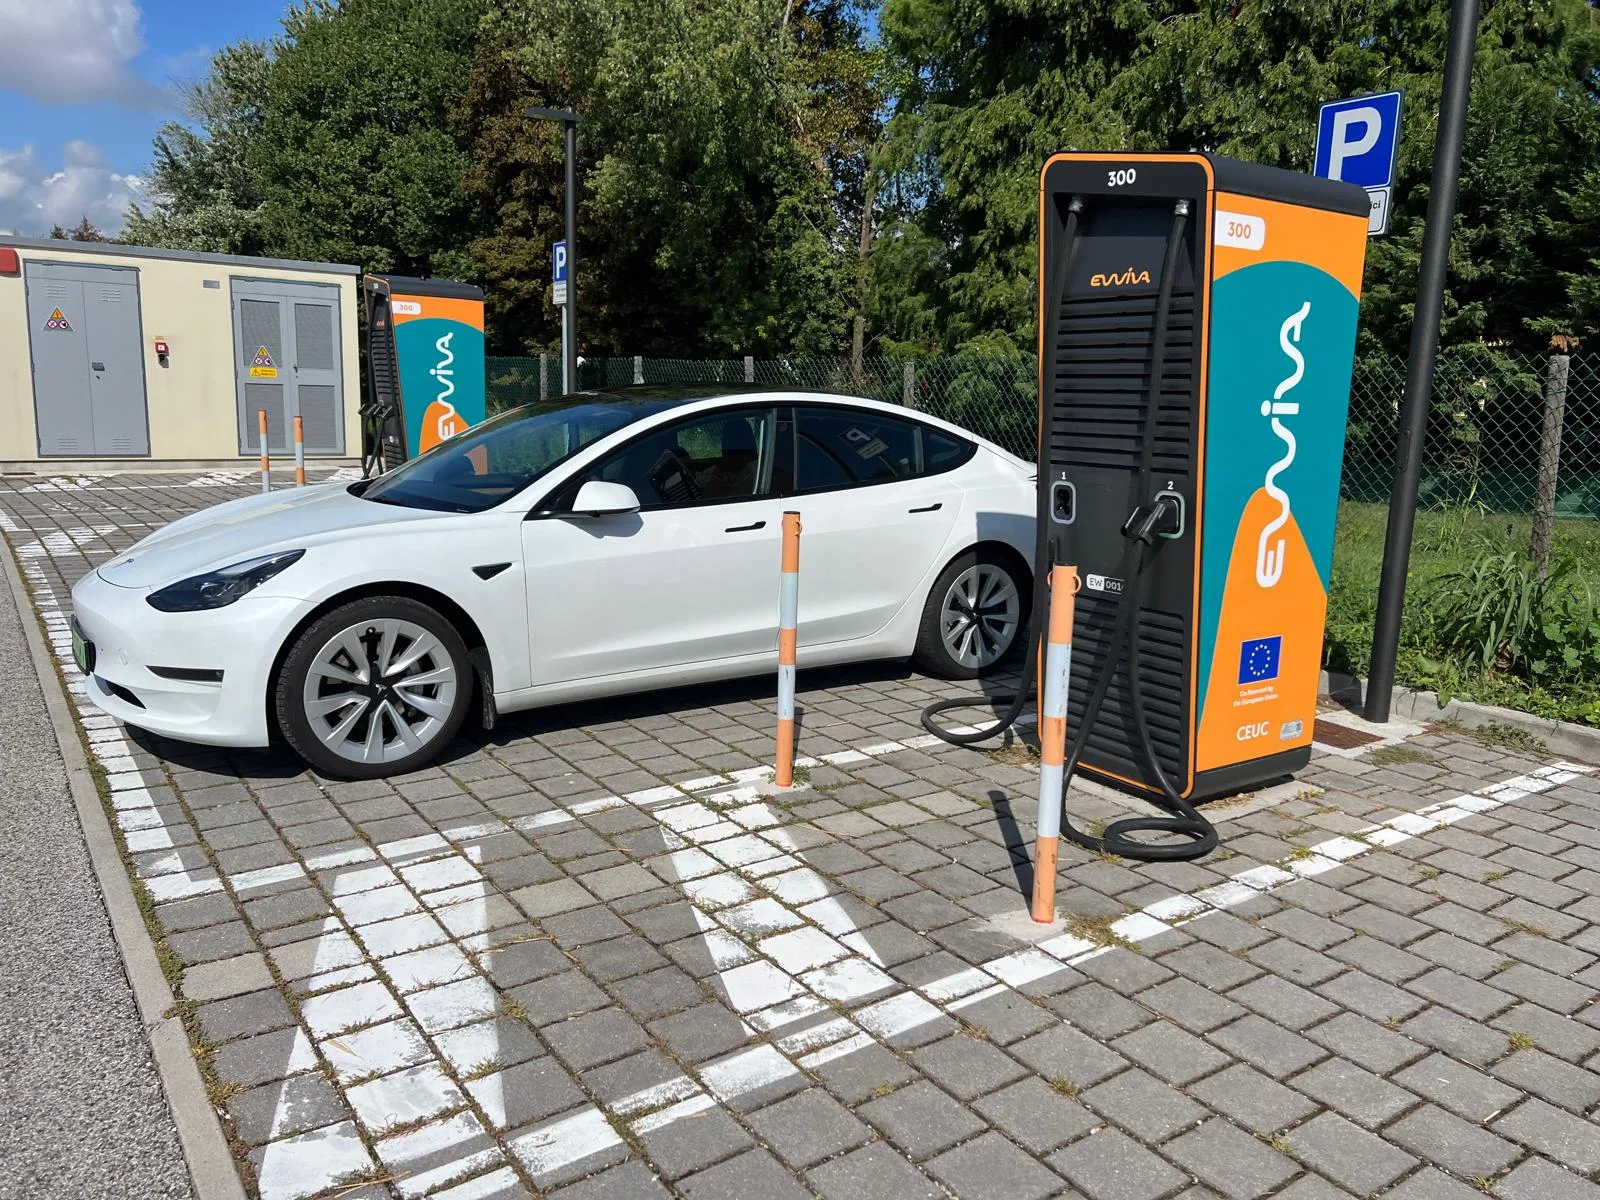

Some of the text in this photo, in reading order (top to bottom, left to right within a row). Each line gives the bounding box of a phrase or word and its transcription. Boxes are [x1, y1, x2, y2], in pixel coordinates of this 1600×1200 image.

[1328, 106, 1382, 182] P
[1107, 168, 1137, 187] 300
[1227, 221, 1252, 240] 300
[556, 246, 567, 279] P
[399, 304, 413, 312] 300
[1061, 471, 1067, 480] 1
[1167, 481, 1175, 490] 2
[1089, 577, 1124, 592] EW 001
[1236, 721, 1269, 741] CEUC
